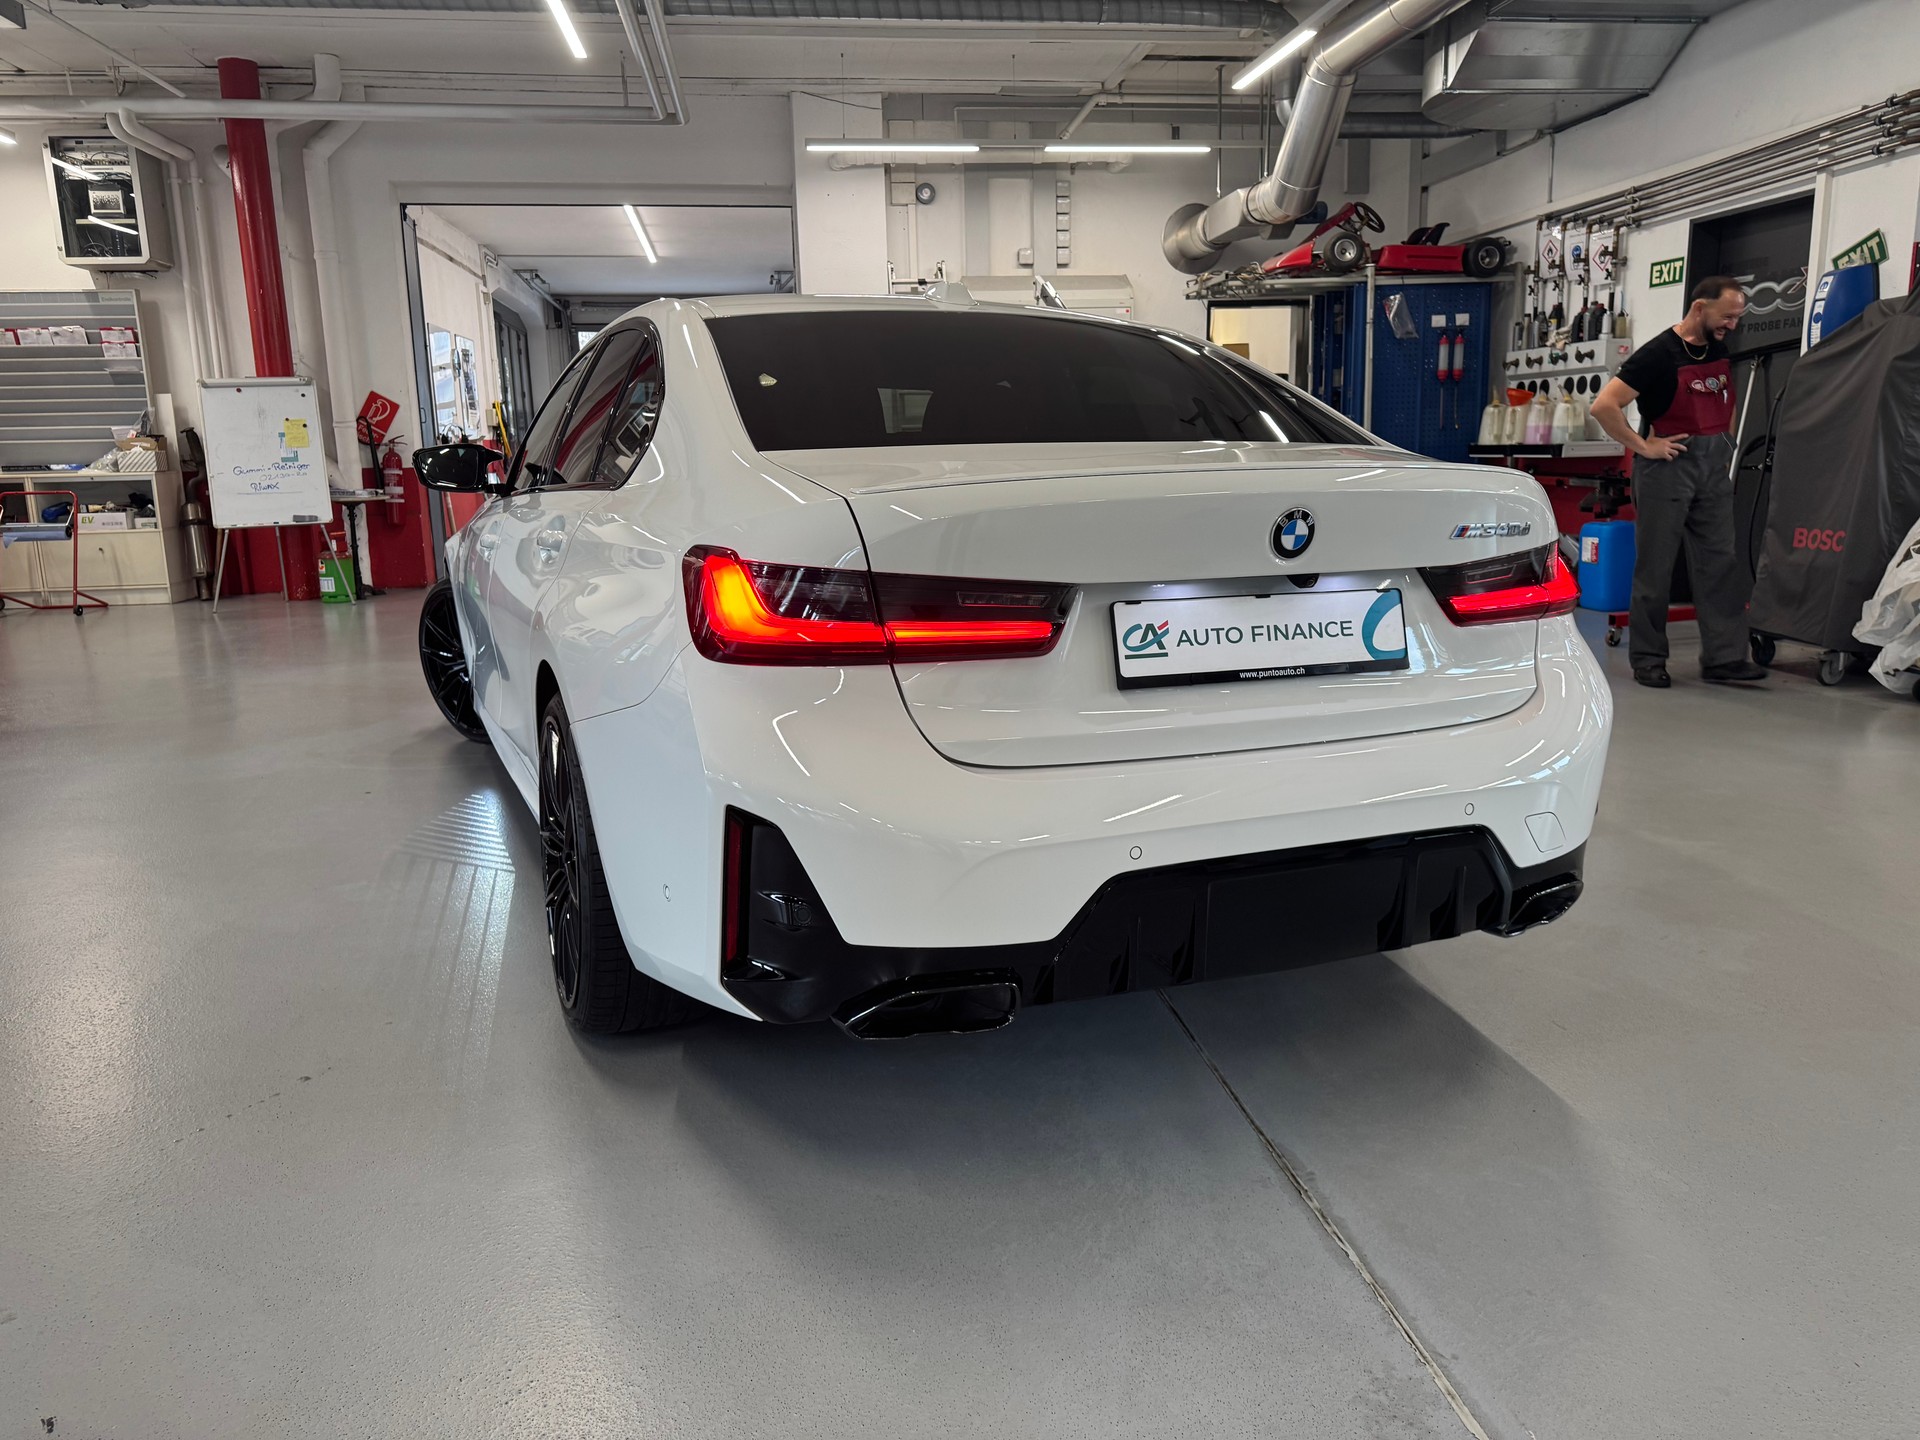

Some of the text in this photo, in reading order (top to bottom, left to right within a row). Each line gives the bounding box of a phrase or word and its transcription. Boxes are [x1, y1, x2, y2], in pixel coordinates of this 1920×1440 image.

[1651, 260, 1683, 285] EXIT
[1747, 319, 1781, 333] PROBE
[81, 516, 94, 524] EV
[1279, 510, 1314, 527] BMW
[1792, 527, 1847, 552] BOSC
[1176, 626, 1244, 648] AUTO
[1251, 620, 1354, 642] FINANCE
[1239, 667, 1306, 679] www.puntoauto.ch
